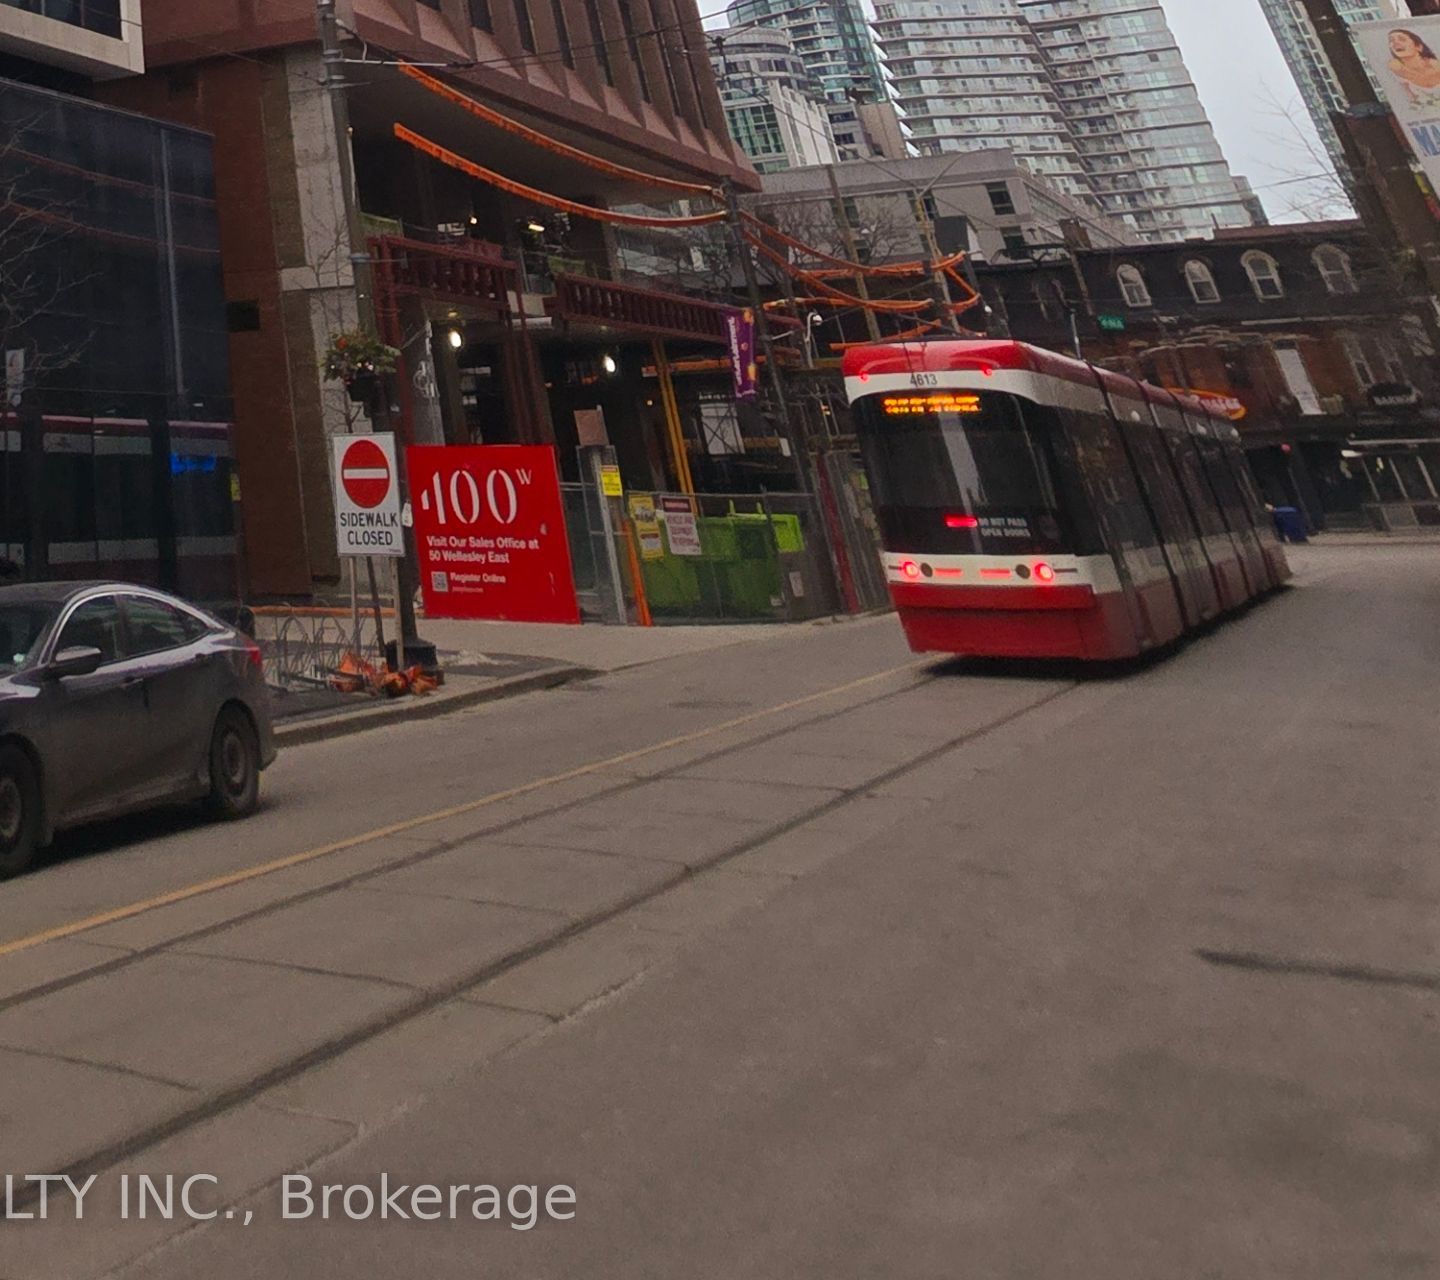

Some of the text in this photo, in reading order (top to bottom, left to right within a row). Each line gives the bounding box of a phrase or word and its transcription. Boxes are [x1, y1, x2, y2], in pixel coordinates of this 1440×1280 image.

[340, 512, 398, 527] SIDEWALK
[347, 530, 393, 545] CLOSED
[426, 535, 539, 549] Visit Our Sales Office at
[429, 550, 510, 564] 50 Wellesley East
[450, 572, 506, 583] Register Online
